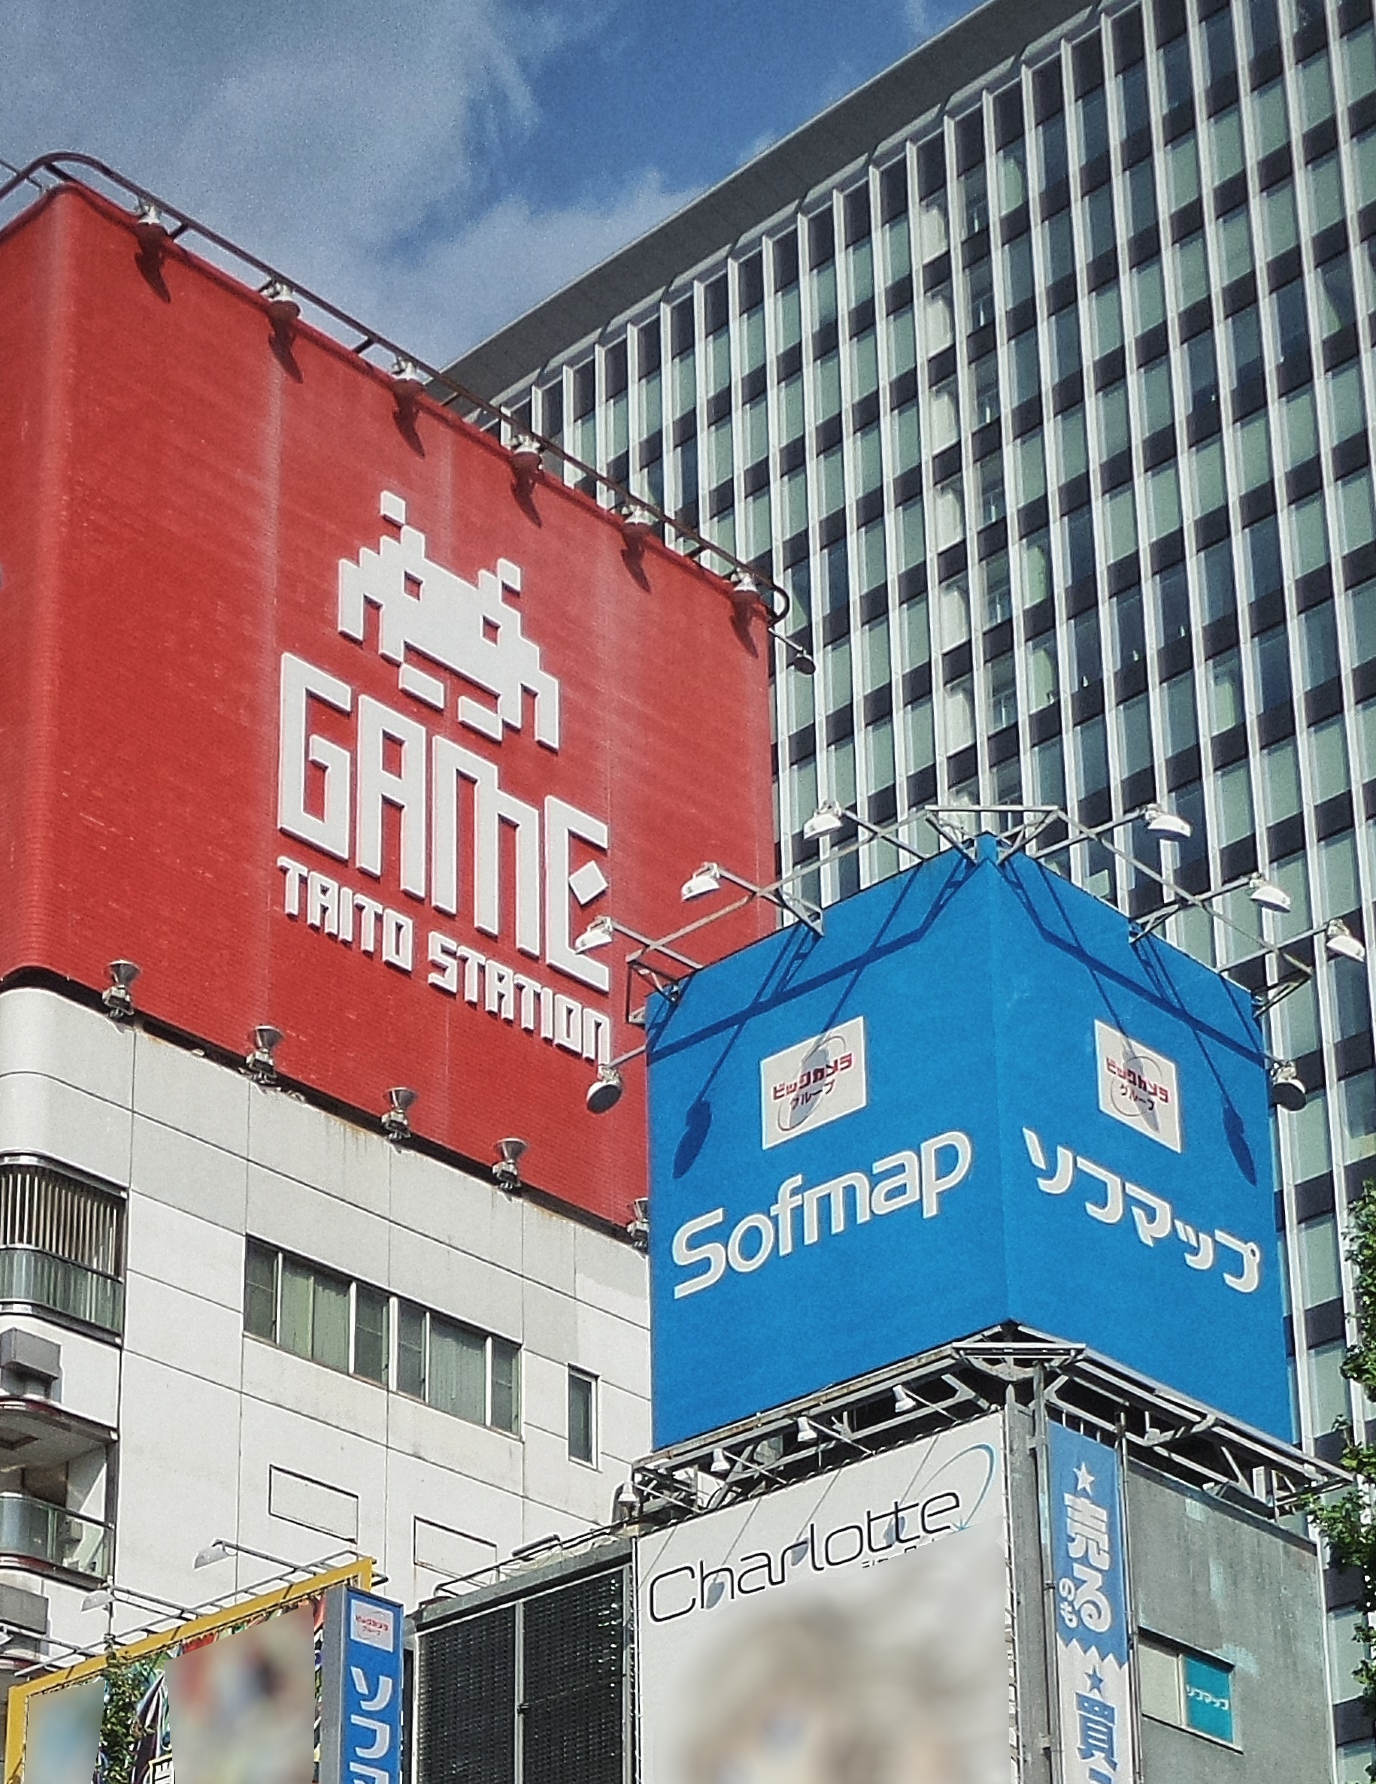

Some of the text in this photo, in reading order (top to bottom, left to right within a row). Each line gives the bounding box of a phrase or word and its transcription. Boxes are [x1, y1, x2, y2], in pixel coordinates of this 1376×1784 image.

[277, 650, 612, 992] GAME
[277, 853, 614, 1066] TAITO STATION
[772, 1052, 854, 1101] ビックカメラ
[789, 1078, 836, 1111] グループ
[1105, 1056, 1171, 1104] ビックカメラ
[672, 1131, 974, 1299] Sofmap
[1021, 1127, 1262, 1293] ソフマップ
[648, 1490, 962, 1625] Charlotte
